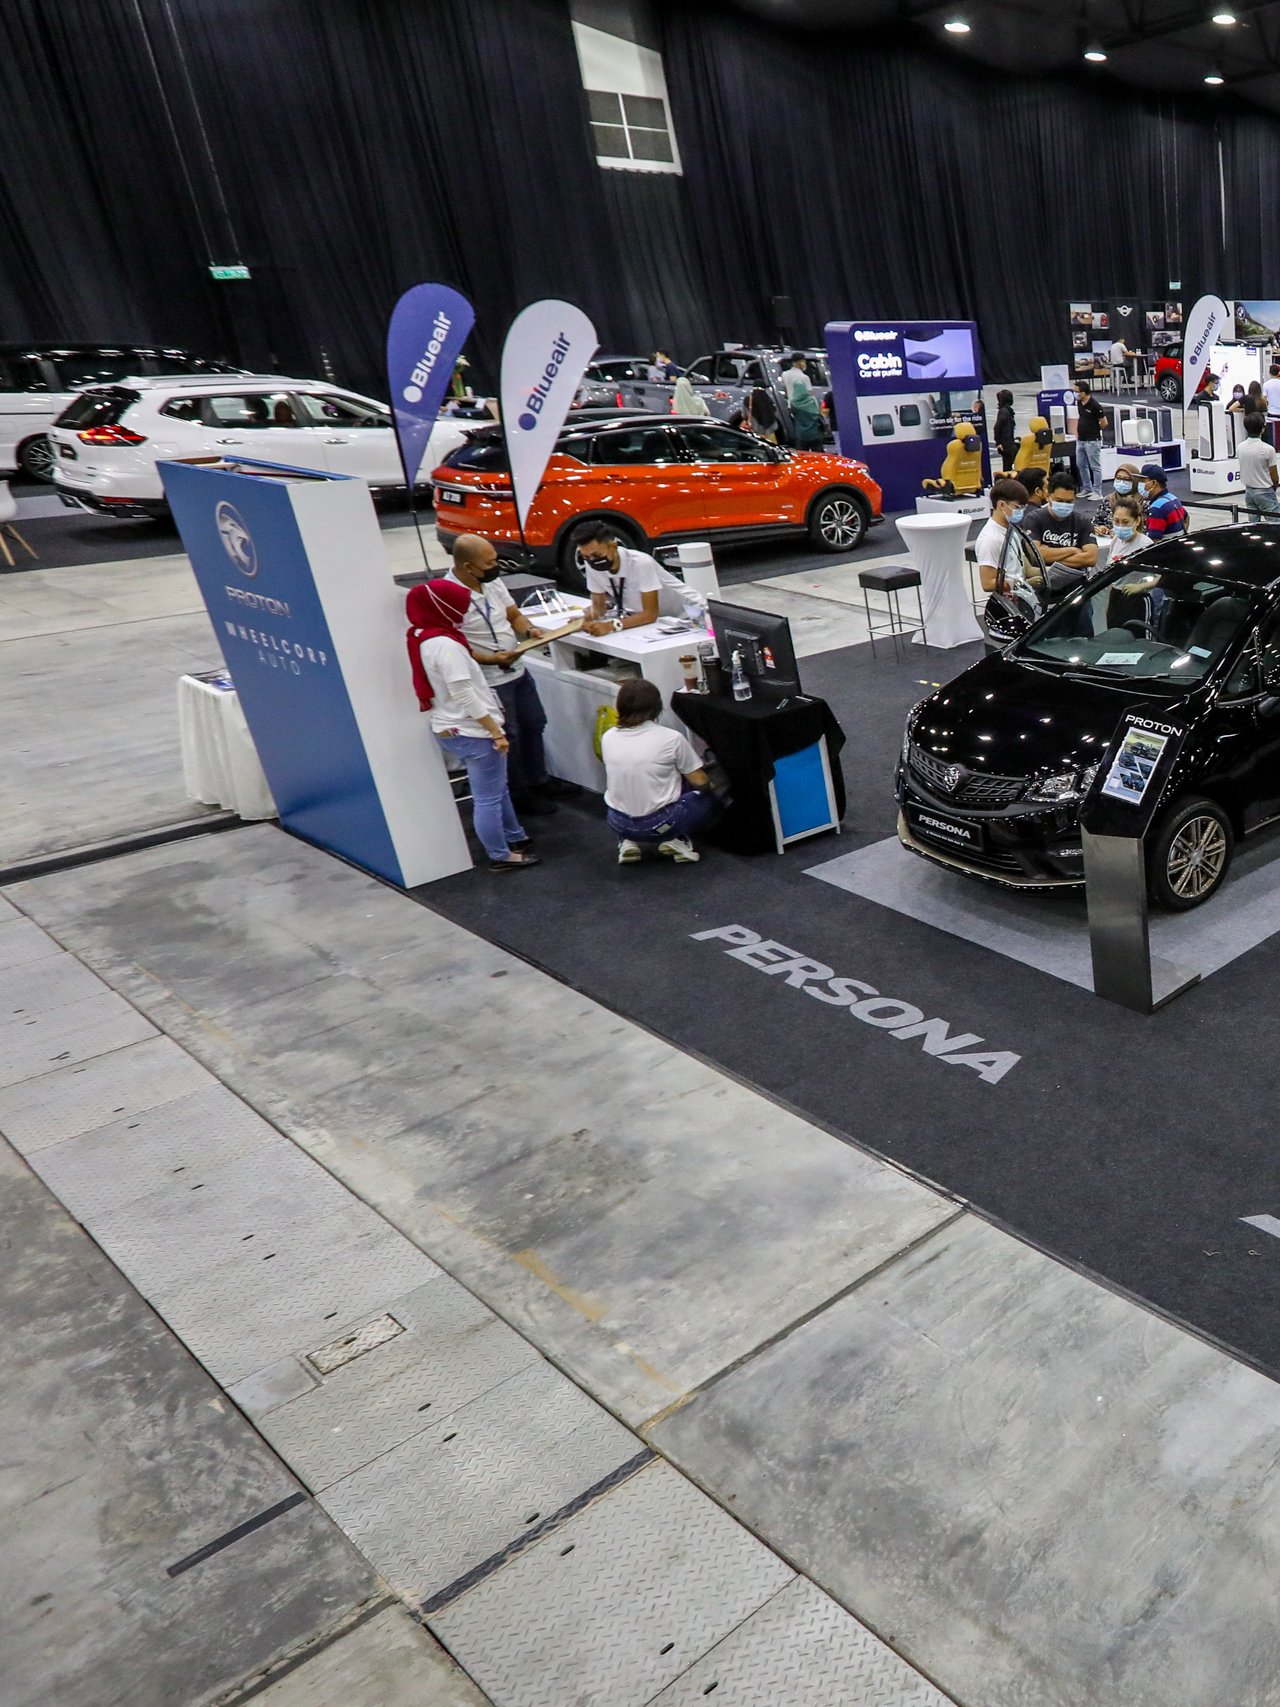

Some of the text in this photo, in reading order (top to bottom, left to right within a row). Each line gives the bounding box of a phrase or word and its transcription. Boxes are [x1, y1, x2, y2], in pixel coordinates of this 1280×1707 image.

[863, 330, 898, 341] Blueair
[1196, 312, 1216, 357] Blueair
[410, 311, 452, 388] Blueair
[857, 352, 903, 370] Cabin
[526, 332, 571, 415] Blueair
[859, 369, 872, 378] Car
[872, 369, 882, 377] air
[963, 507, 986, 515] Blueair
[225, 585, 293, 618] PROTON
[258, 649, 300, 675] AUTO
[1125, 714, 1183, 737] PROTON
[918, 814, 971, 839] PERSONA
[688, 924, 1022, 1085] PERSONA
